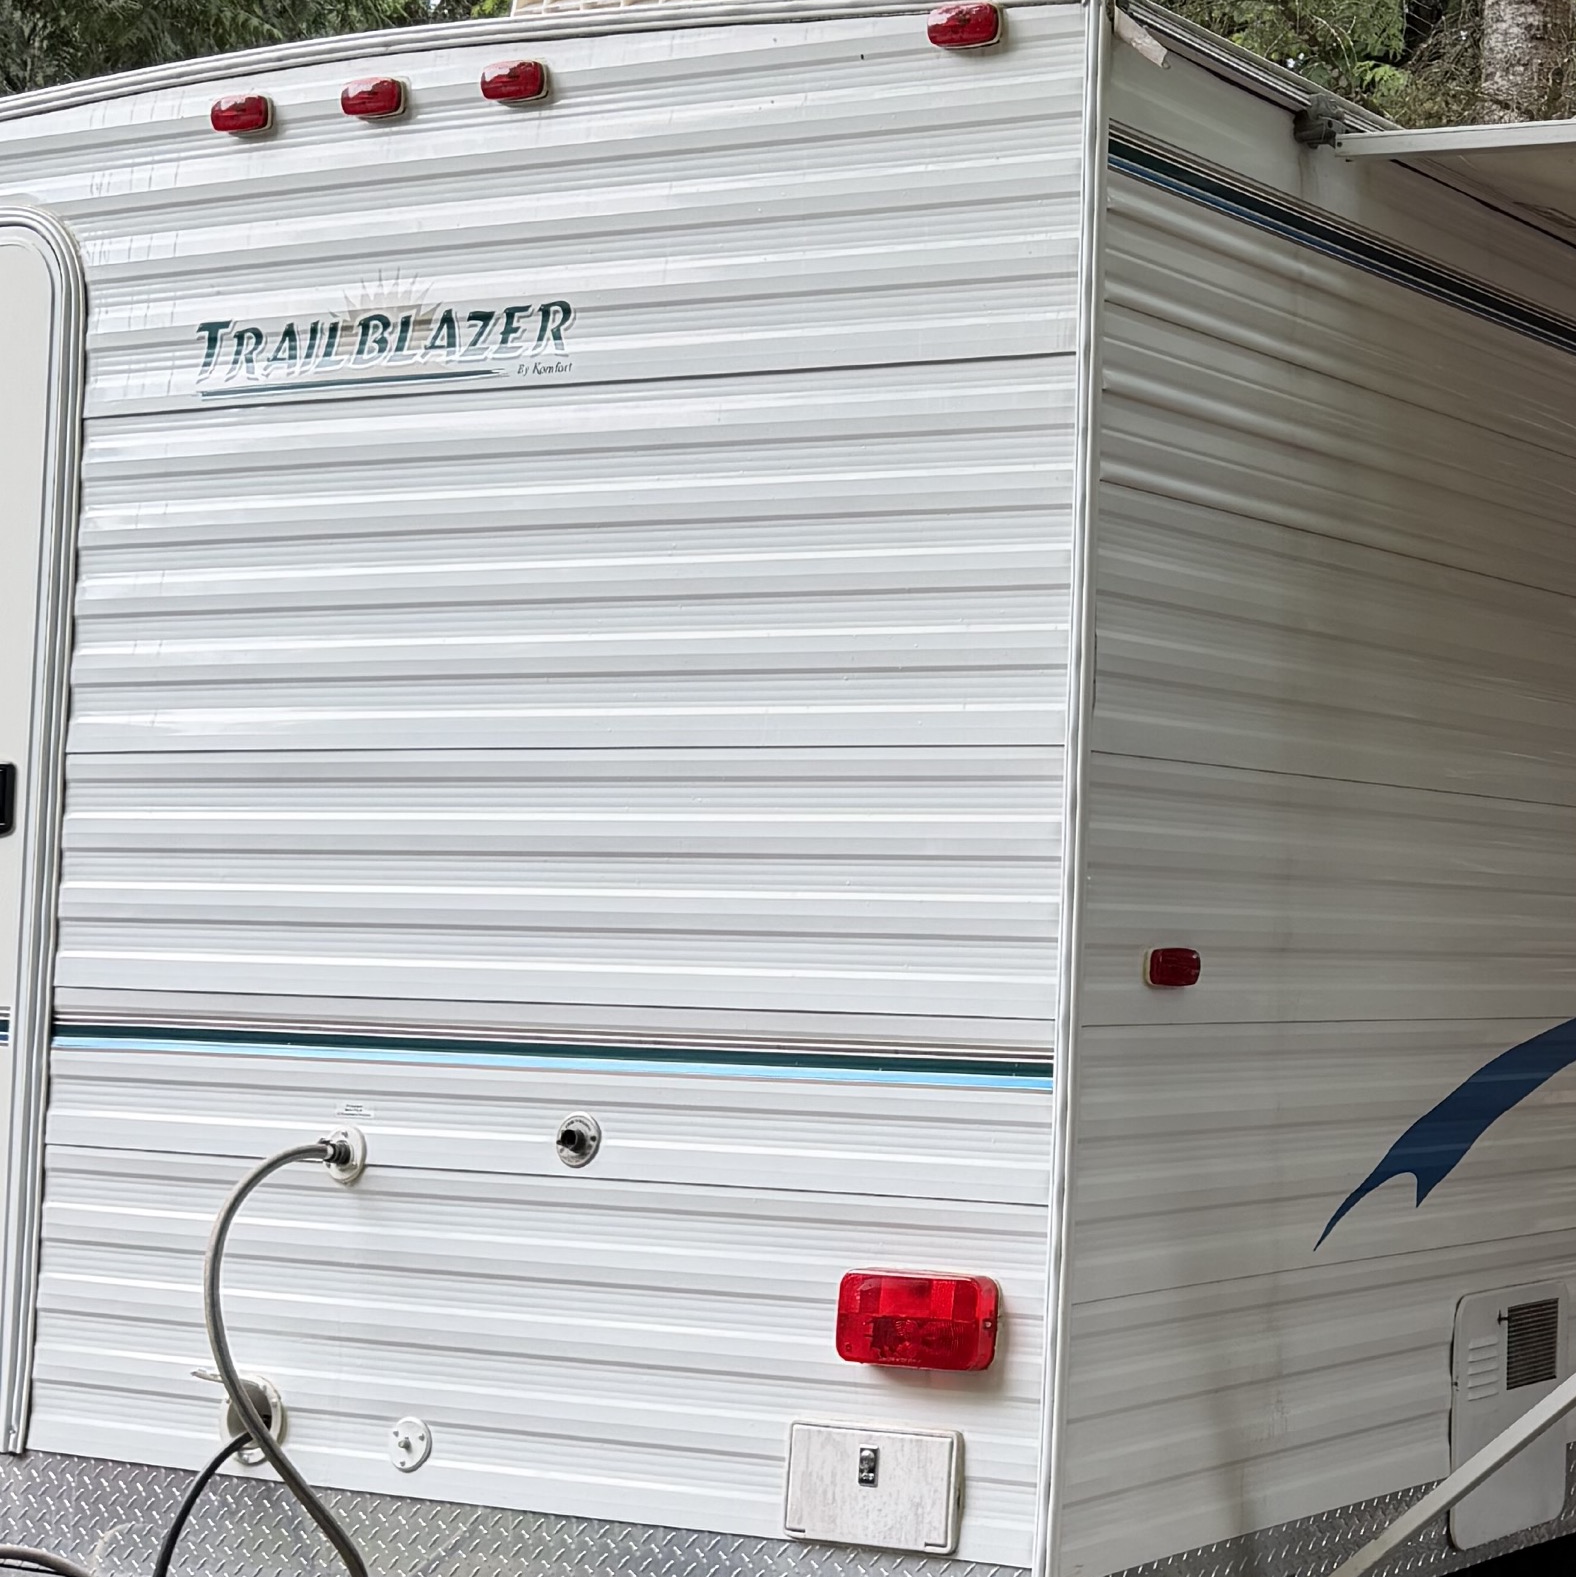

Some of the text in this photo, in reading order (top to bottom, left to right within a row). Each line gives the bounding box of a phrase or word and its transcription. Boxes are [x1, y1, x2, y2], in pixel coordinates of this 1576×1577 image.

[196, 299, 575, 384] TRAILBLAZER
[517, 361, 573, 377] By Komfort
